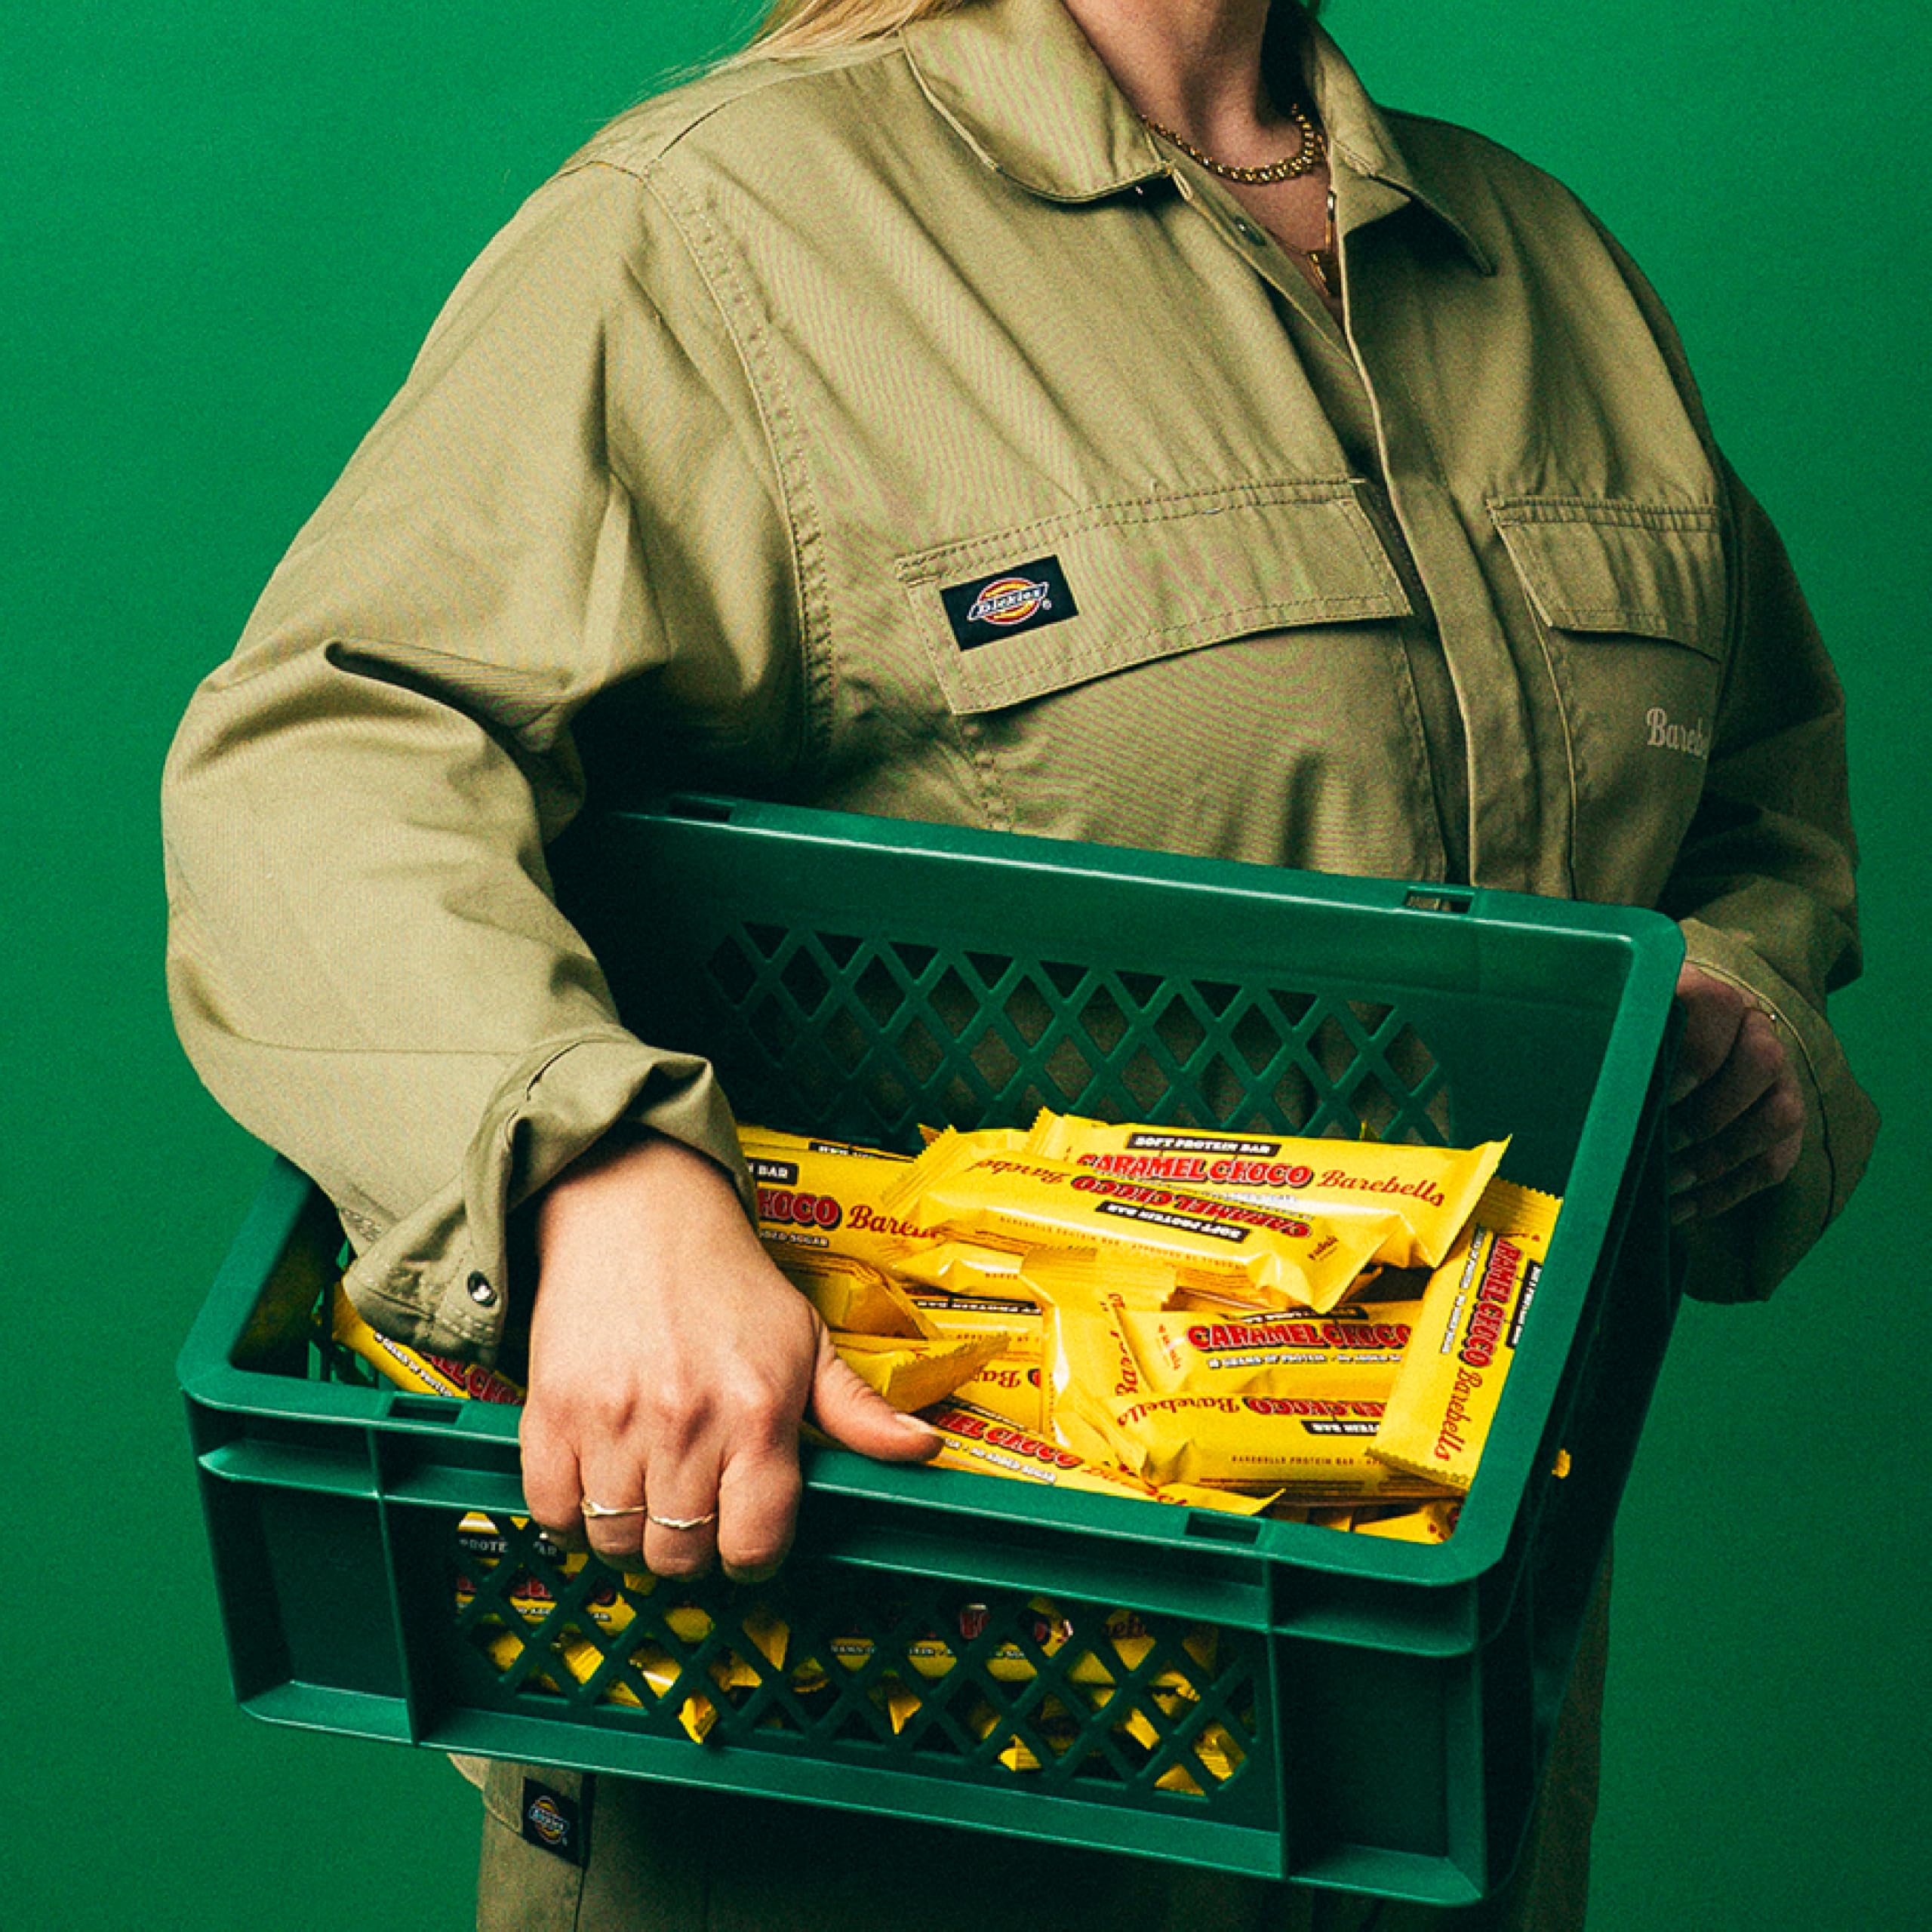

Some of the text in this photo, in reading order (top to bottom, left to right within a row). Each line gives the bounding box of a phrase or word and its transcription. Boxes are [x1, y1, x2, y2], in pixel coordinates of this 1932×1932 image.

[1077, 1154, 1208, 1182] CARAMEL
[1208, 1159, 1313, 1189] CHOCO
[1316, 1169, 1445, 1208] Barebells
[757, 1189, 843, 1231] HOCO
[1186, 1323, 1331, 1352] CARAMEL
[1434, 1366, 1484, 1462] Barebells
